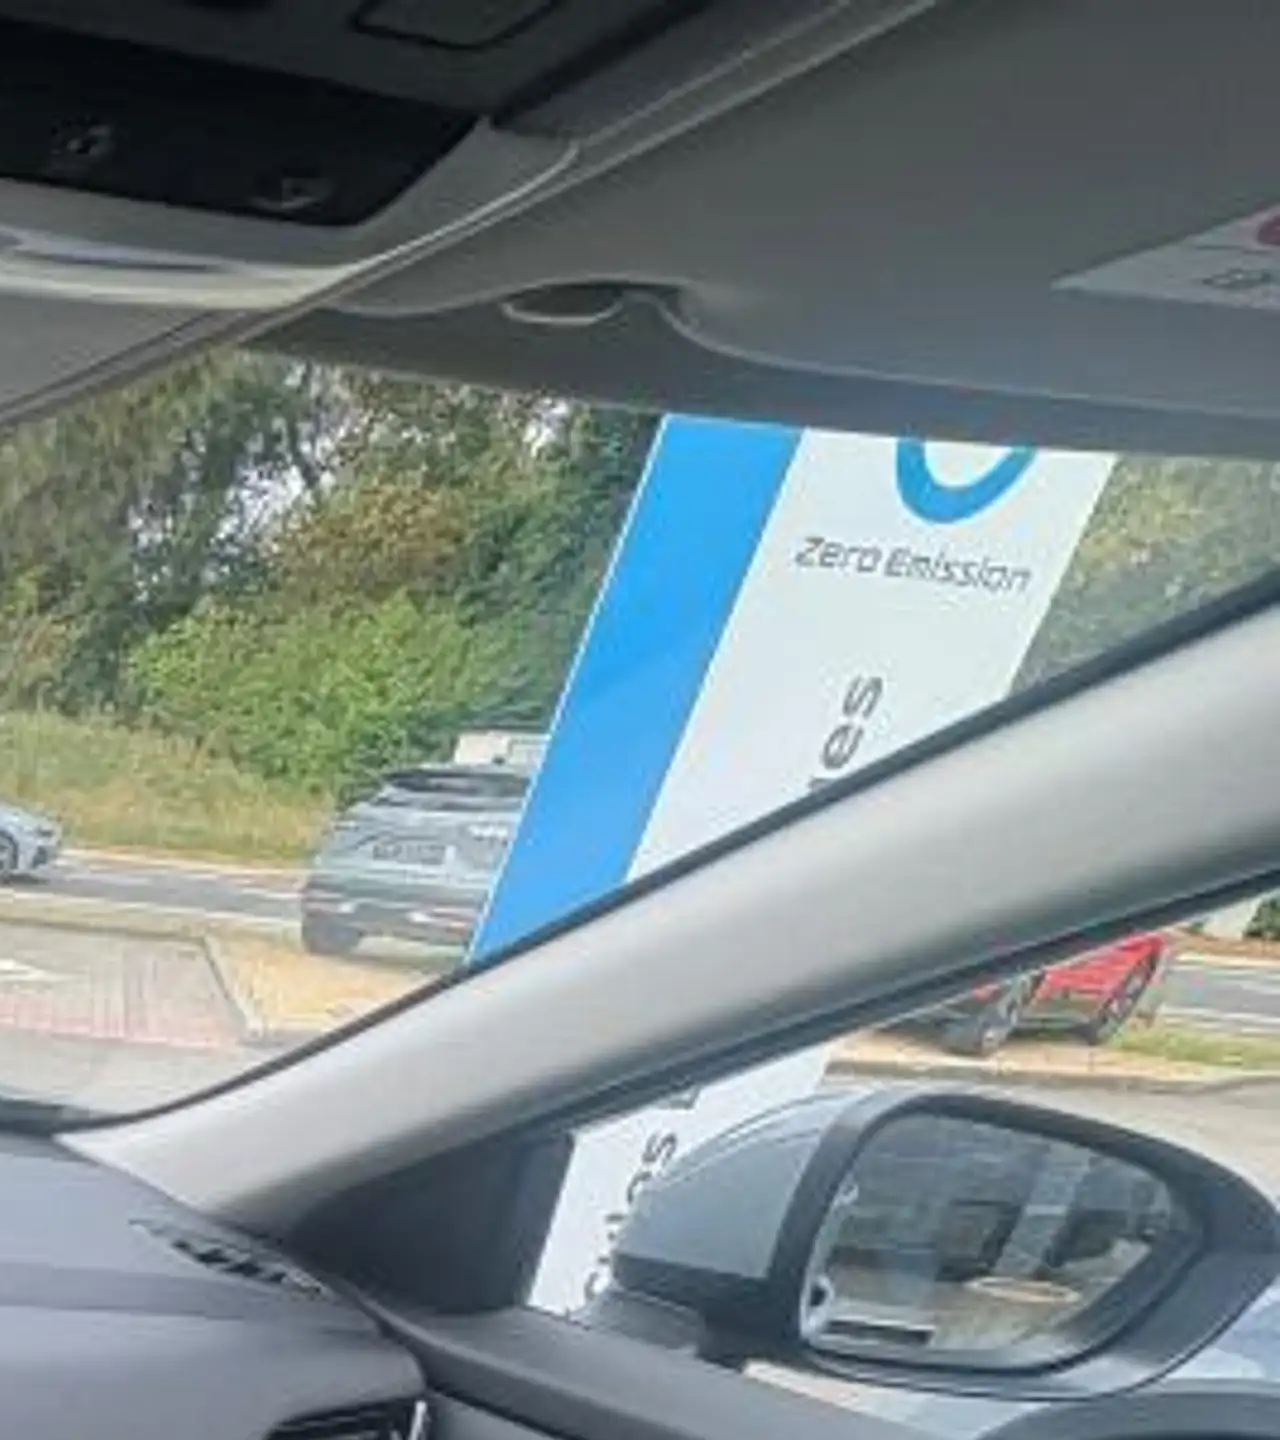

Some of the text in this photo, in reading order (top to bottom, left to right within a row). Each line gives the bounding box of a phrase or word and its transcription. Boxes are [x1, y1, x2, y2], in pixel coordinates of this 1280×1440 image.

[795, 535, 1032, 593] Zero Emission
[812, 674, 884, 782] es
